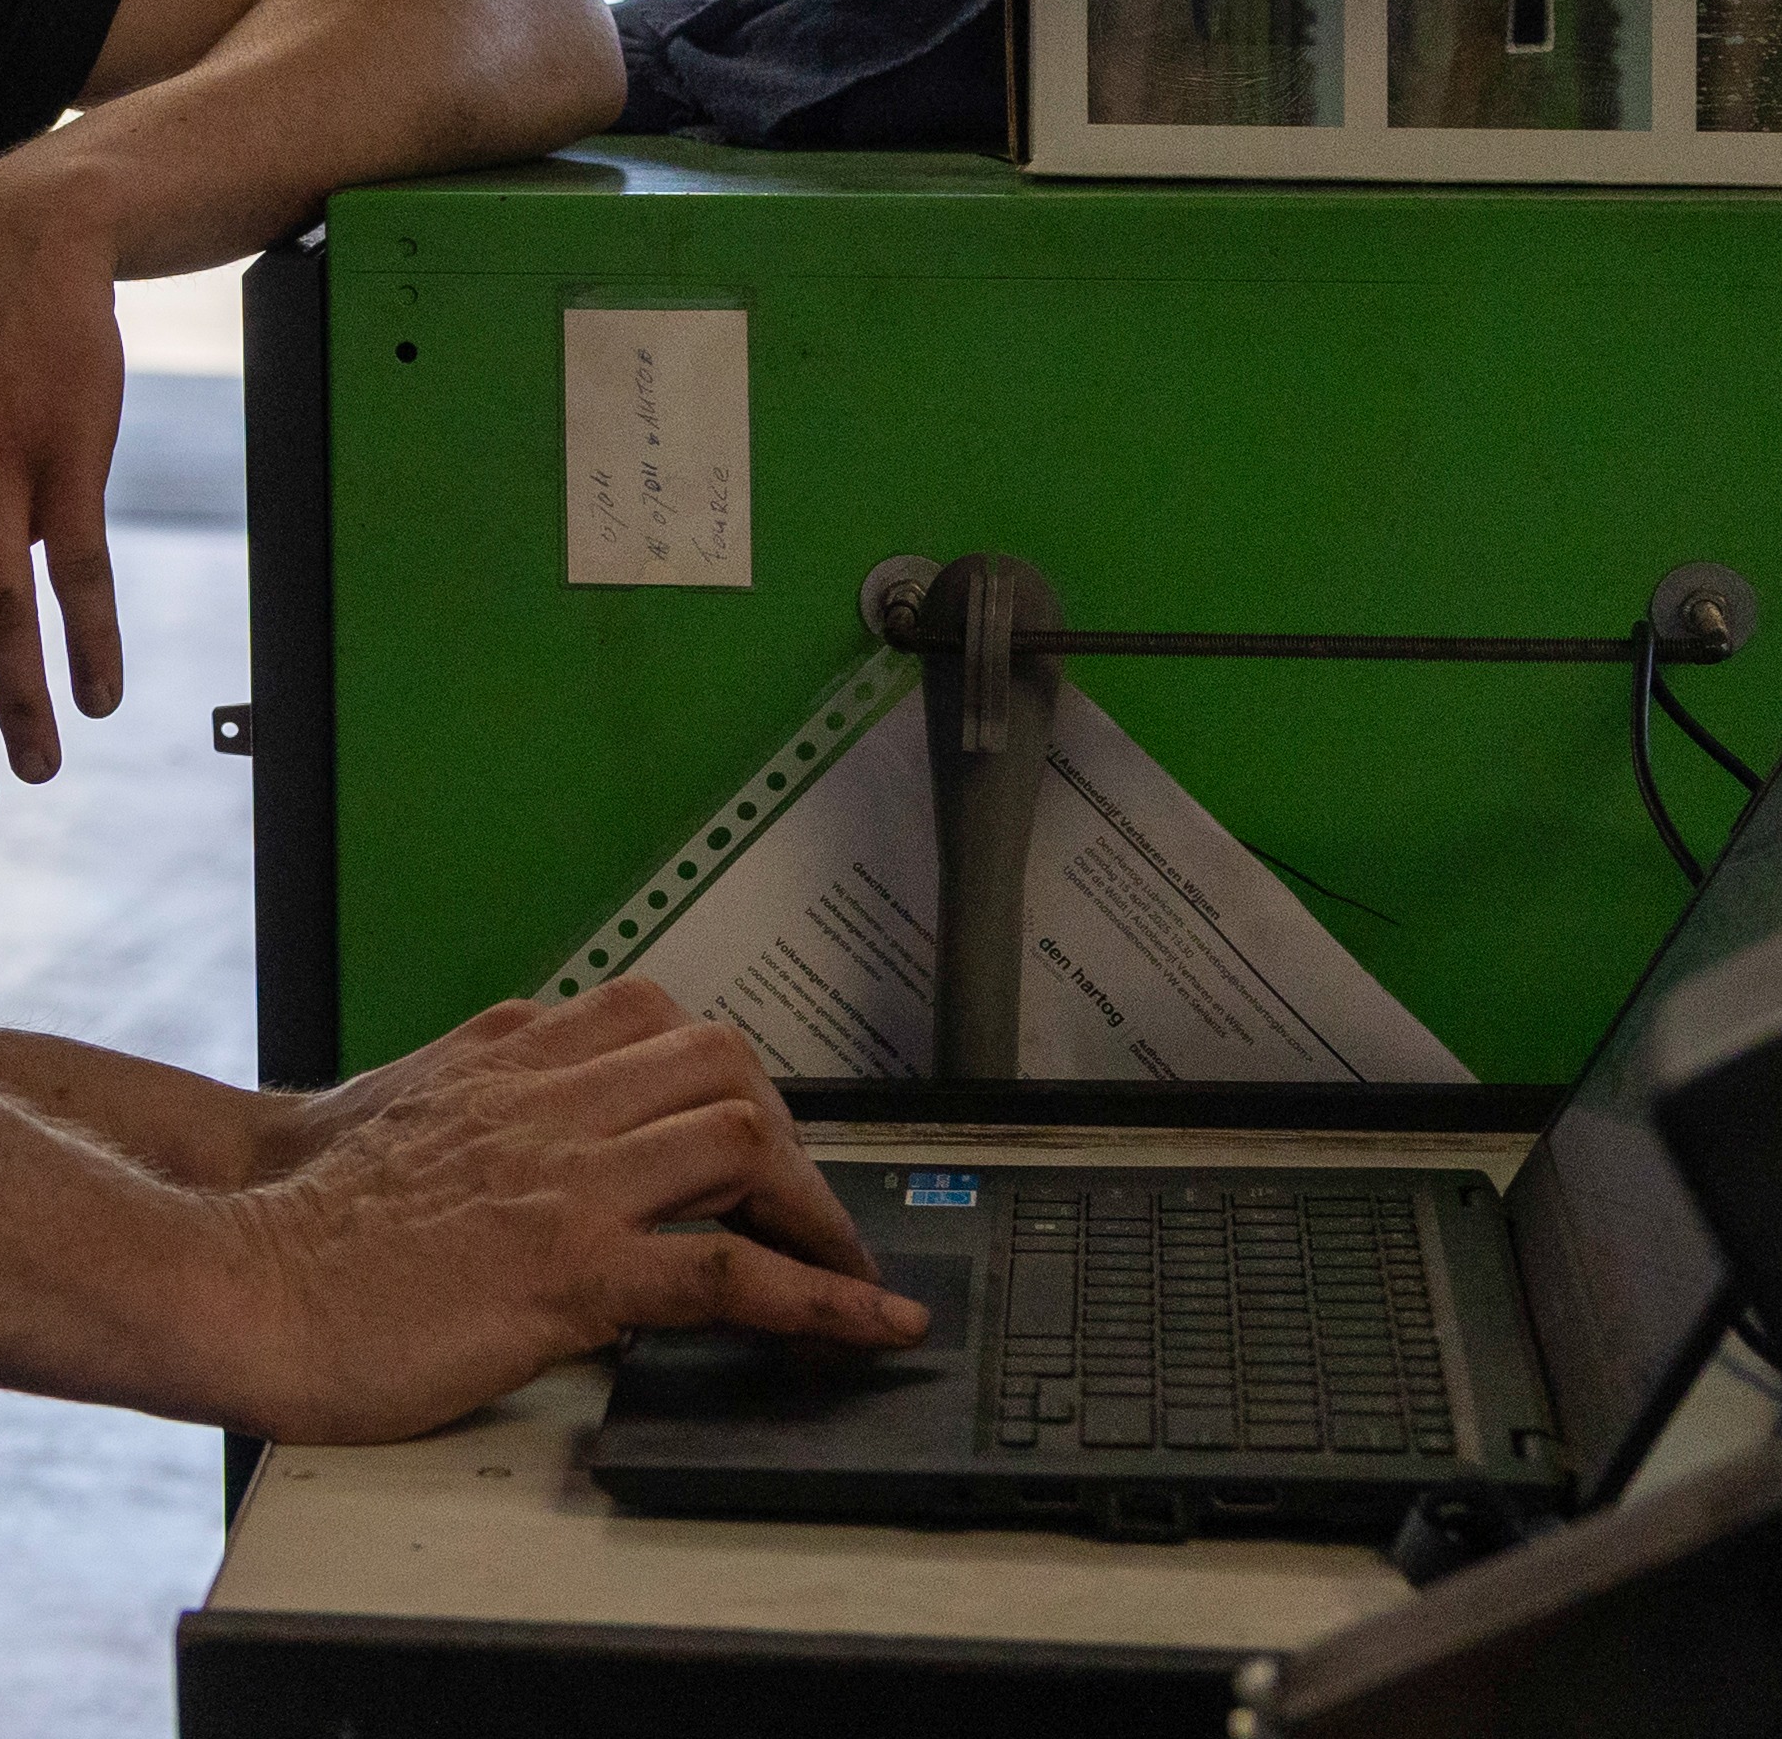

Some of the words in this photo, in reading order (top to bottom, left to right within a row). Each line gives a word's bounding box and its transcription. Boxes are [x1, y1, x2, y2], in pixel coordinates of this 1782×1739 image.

[1055, 755, 1124, 823] Autobedrijf
[1117, 815, 1170, 868] Verharen
[1165, 864, 1183, 883] en
[1178, 878, 1224, 924] Wijnen
[1094, 834, 1115, 857] Den
[1111, 853, 1145, 888] Hartog
[1141, 882, 1187, 929] Lubricants
[816, 893, 868, 944] Volkswagen
[850, 859, 893, 902] Geachte
[889, 897, 940, 948] automotiv
[1058, 864, 1096, 903] Update
[1161, 968, 1179, 987] VW
[1175, 986, 1190, 1000] en
[1071, 854, 1095, 878] Olaf
[1090, 874, 1106, 889] de
[1102, 886, 1128, 912] Wildt
[1129, 913, 1179, 965] Autobedrijf
[1175, 962, 1215, 1004] Verharen
[1211, 1001, 1226, 1015] en
[1081, 844, 1119, 883] dinsdag
[1117, 879, 1132, 894] 15
[1127, 890, 1151, 915] april
[1146, 909, 1172, 936] 2025
[759, 950, 781, 972] Voor
[771, 935, 831, 994] Volkswagen
[826, 988, 901, 1062] Bedrijfswagens
[1036, 933, 1075, 972] den
[1065, 966, 1128, 1030] hartog
[714, 994, 729, 1010] De
[725, 1006, 765, 1046] volgende
[763, 1041, 796, 1074] normen
